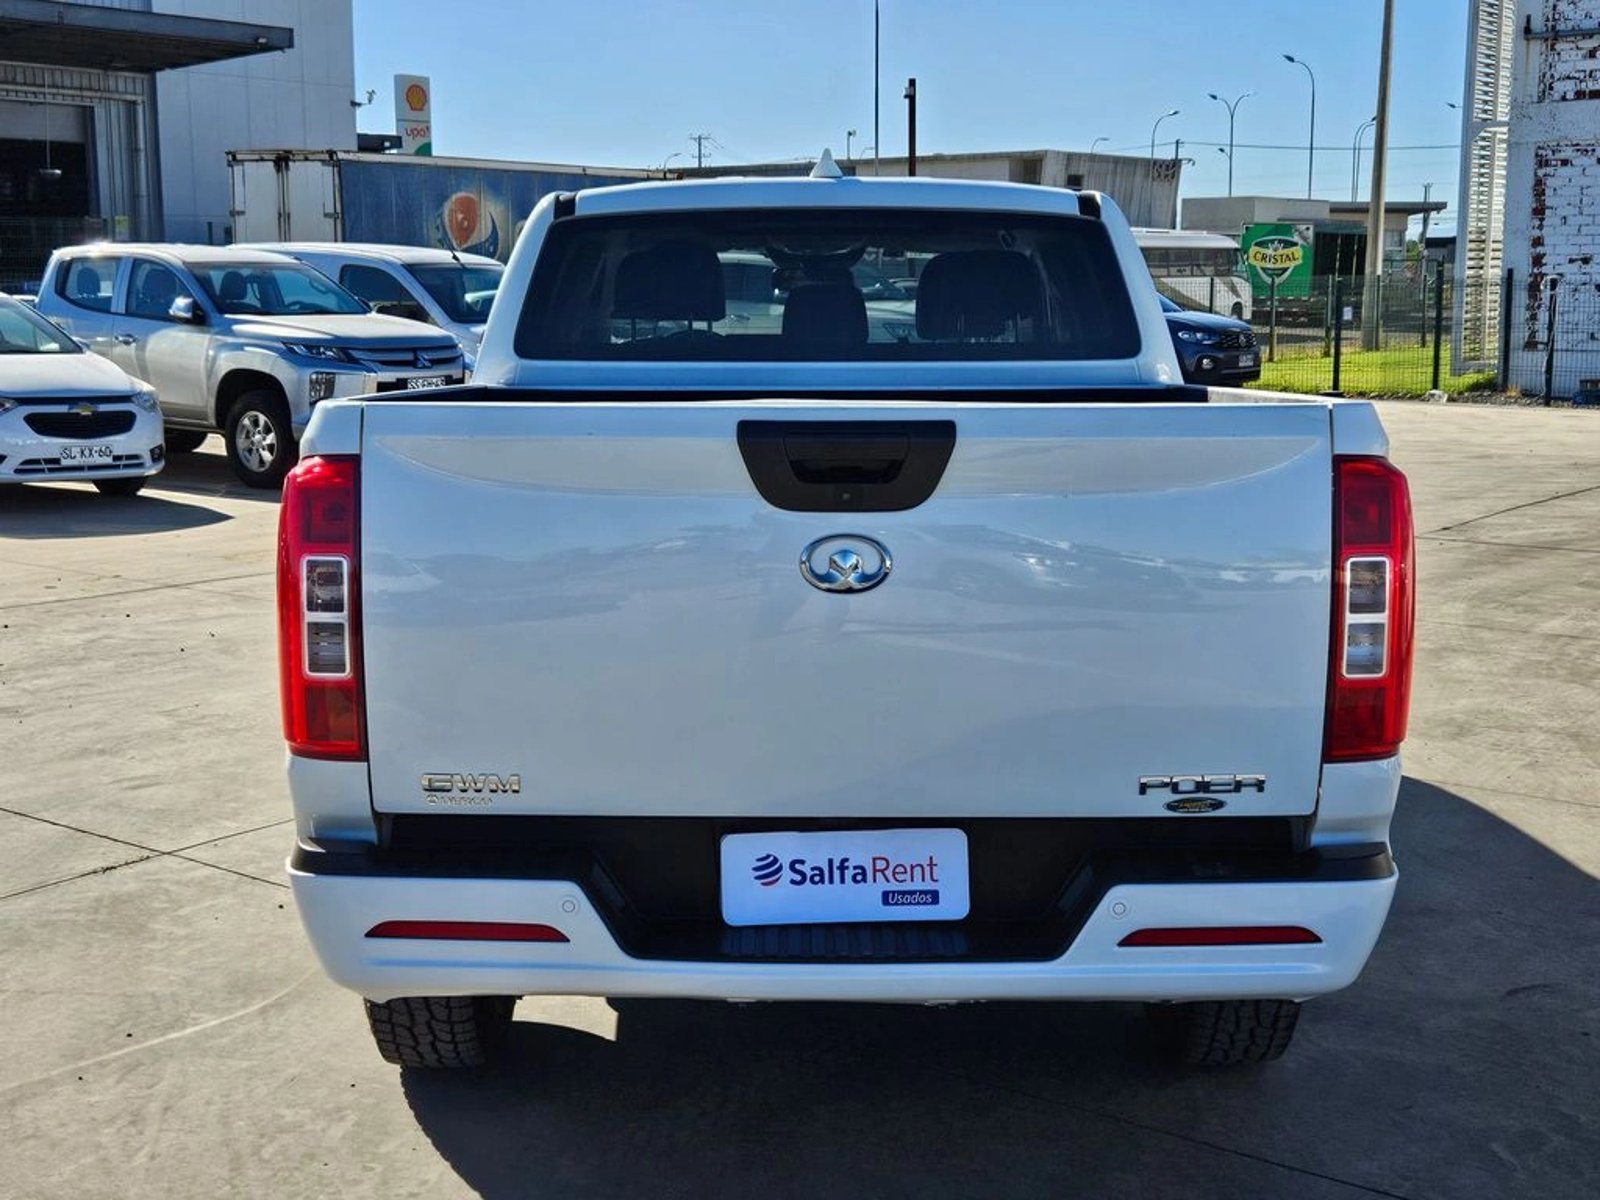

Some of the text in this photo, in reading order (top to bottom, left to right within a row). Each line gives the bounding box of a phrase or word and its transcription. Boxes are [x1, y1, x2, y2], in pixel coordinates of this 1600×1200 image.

[1253, 250, 1300, 264] CRISTAL
[421, 773, 520, 793] GWM
[1139, 775, 1265, 794] POER
[888, 892, 933, 904] Usados
